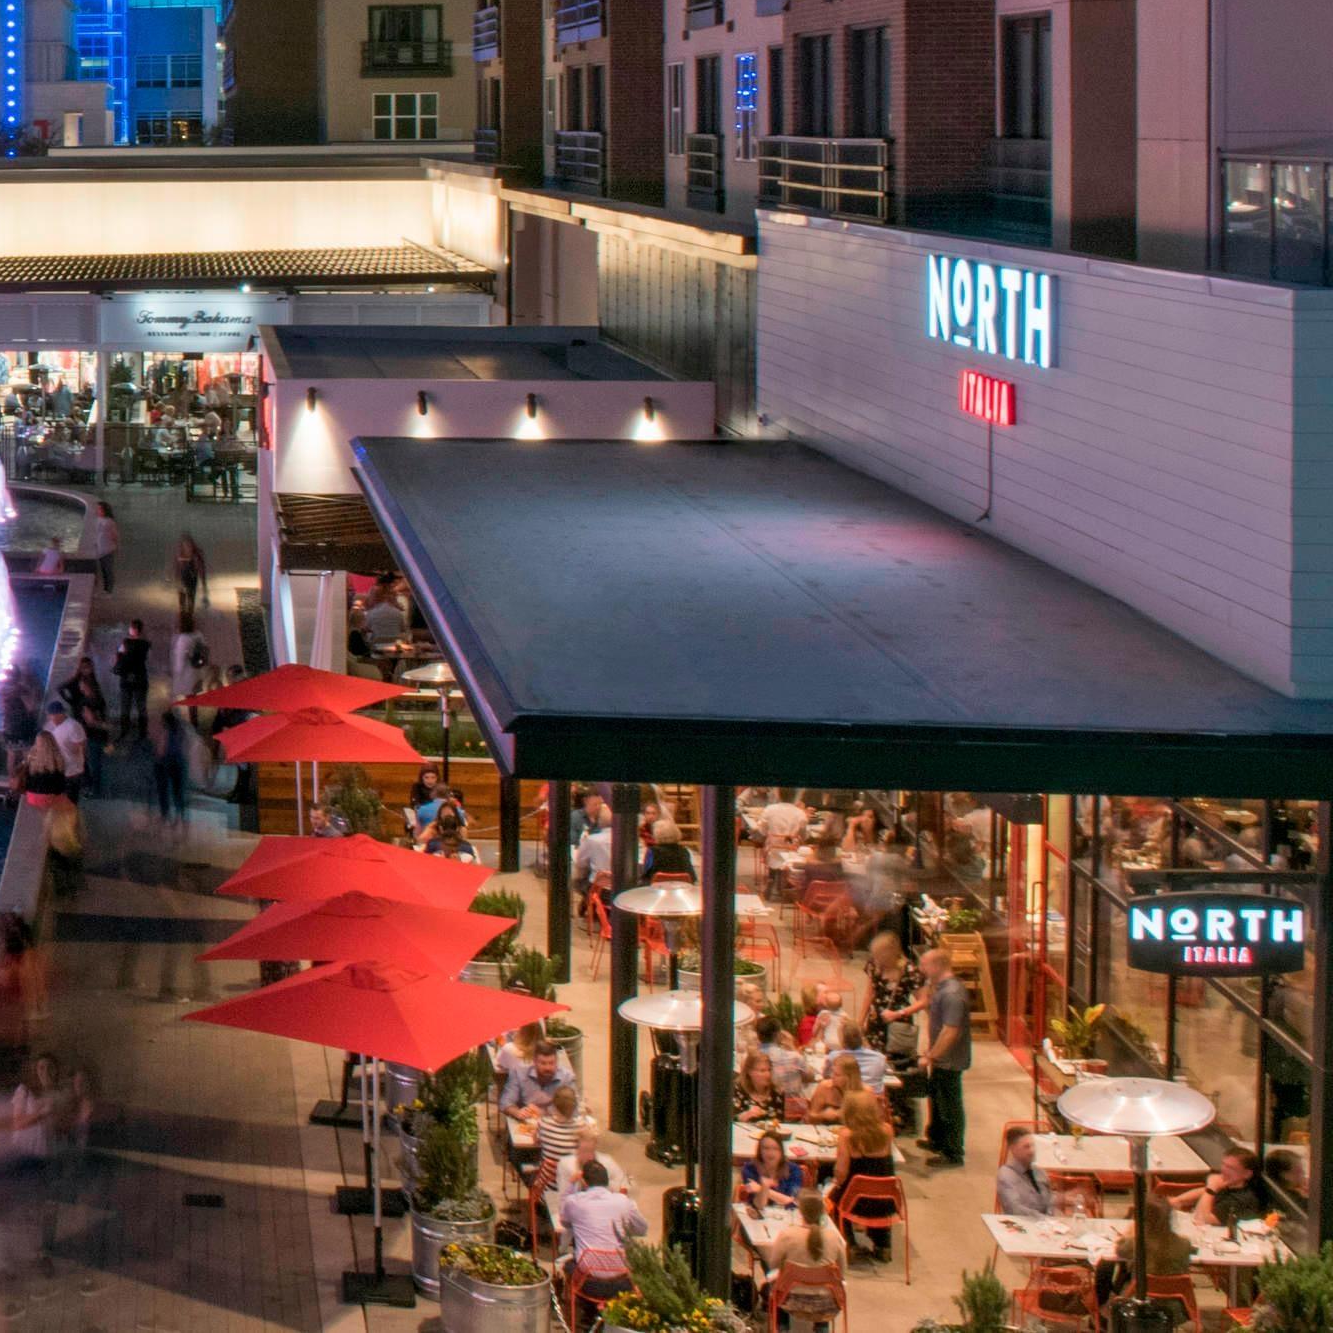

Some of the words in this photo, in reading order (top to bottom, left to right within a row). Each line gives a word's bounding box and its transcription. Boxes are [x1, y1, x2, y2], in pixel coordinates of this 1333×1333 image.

[136, 310, 191, 328] Tommy
[192, 310, 252, 324] Bahama
[926, 253, 1051, 369] NORTH
[960, 369, 1016, 426] ITALIA
[1130, 907, 1304, 942] NORTH
[1183, 946, 1253, 964] ITALIA
